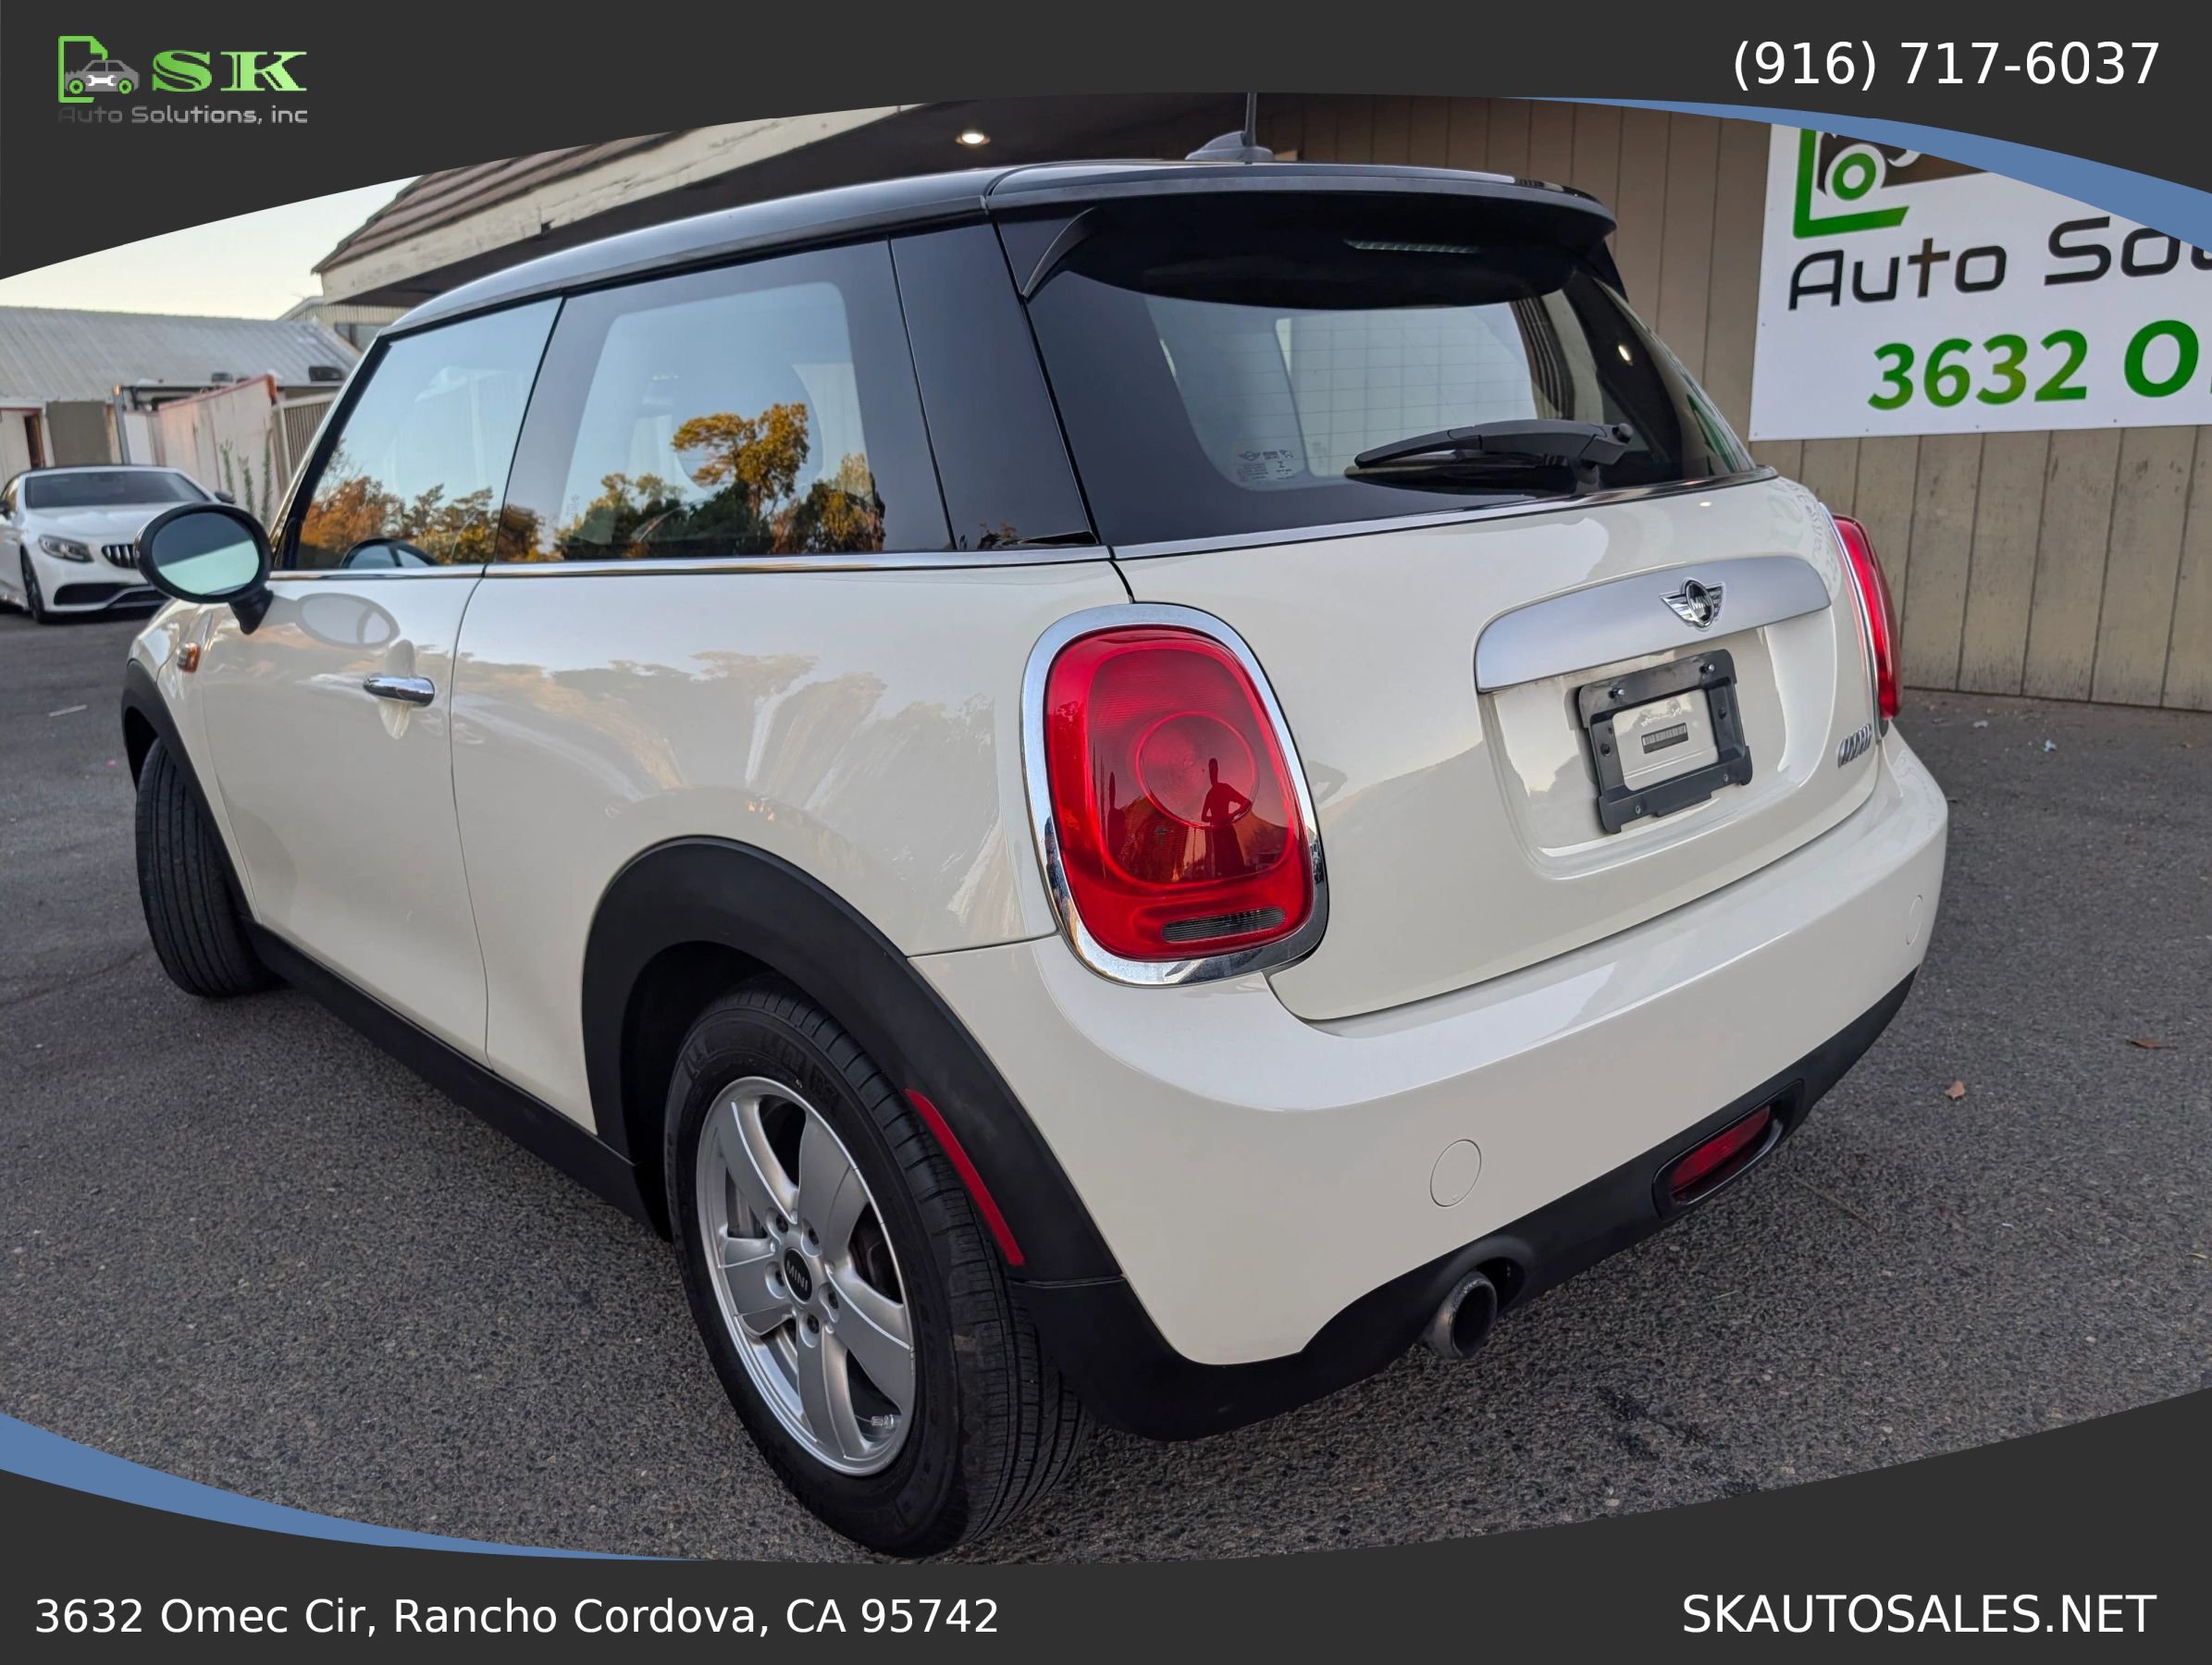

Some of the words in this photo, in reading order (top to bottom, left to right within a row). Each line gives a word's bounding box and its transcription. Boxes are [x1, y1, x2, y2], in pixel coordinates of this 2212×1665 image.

[1788, 238, 2007, 310] Auto
[1867, 329, 2087, 411] 3632
[2124, 319, 2212, 398] O
[786, 1260, 809, 1291] MINI
